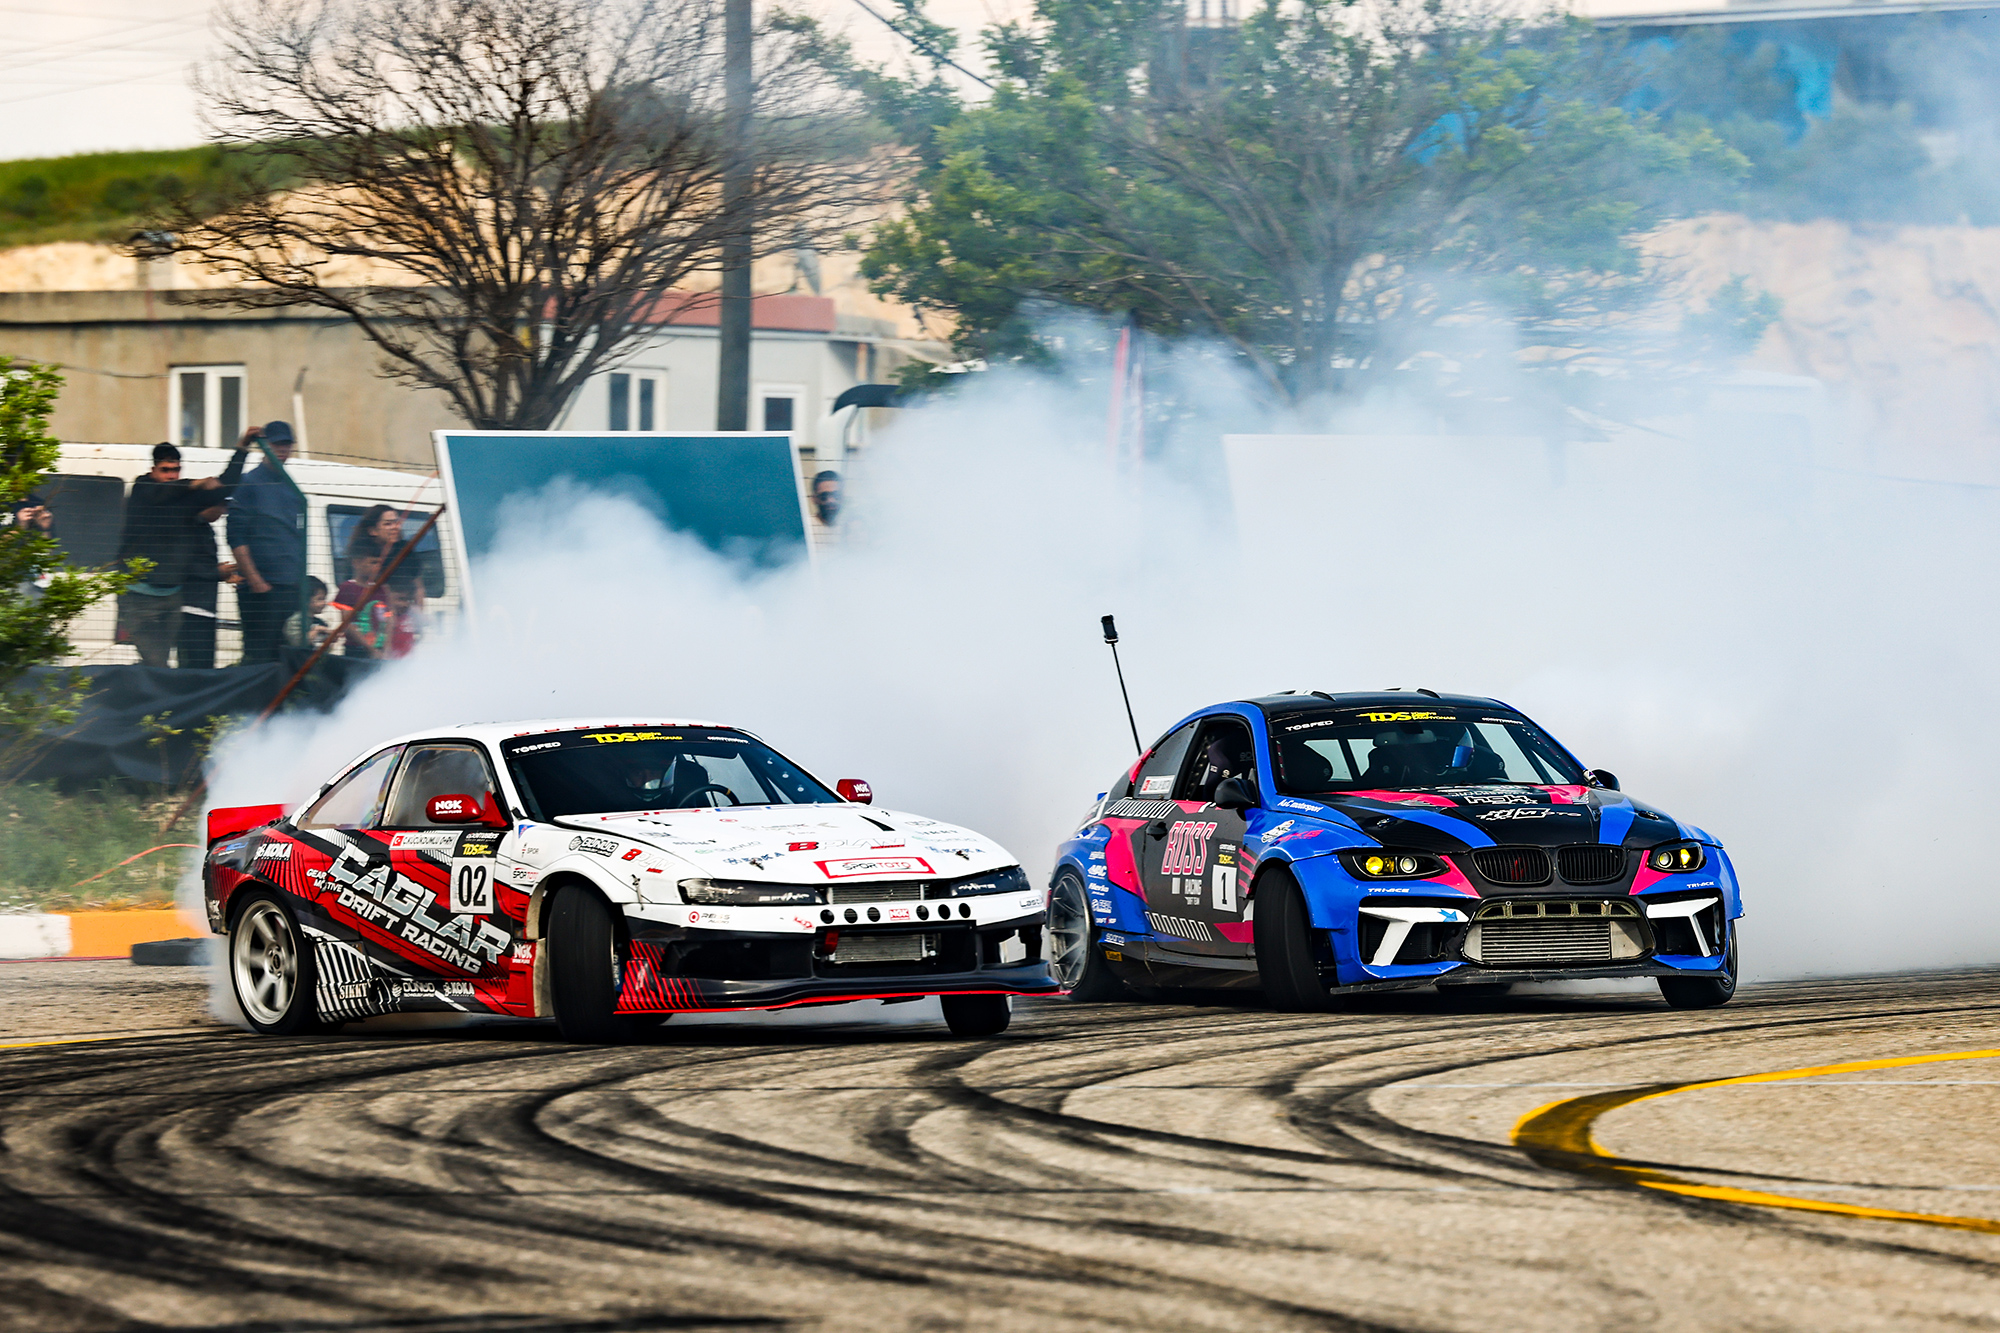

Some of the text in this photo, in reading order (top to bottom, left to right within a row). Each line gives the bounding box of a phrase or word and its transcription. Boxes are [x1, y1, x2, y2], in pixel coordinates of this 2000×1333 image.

[1285, 720, 1334, 732] TOSFED
[512, 742, 561, 754] TOSFED
[853, 783, 869, 793] NGK
[435, 800, 462, 810] NGK
[263, 843, 293, 859] KOKA
[1161, 821, 1218, 875] BOSS
[306, 868, 327, 879] GEAR
[458, 865, 487, 907] 02
[1221, 872, 1228, 905] 1
[890, 909, 909, 918] NGK
[337, 887, 482, 974] DRIFT RACING
[512, 942, 533, 959] NGK
[339, 983, 368, 999] SIKKY
[451, 982, 475, 995] KOKA
